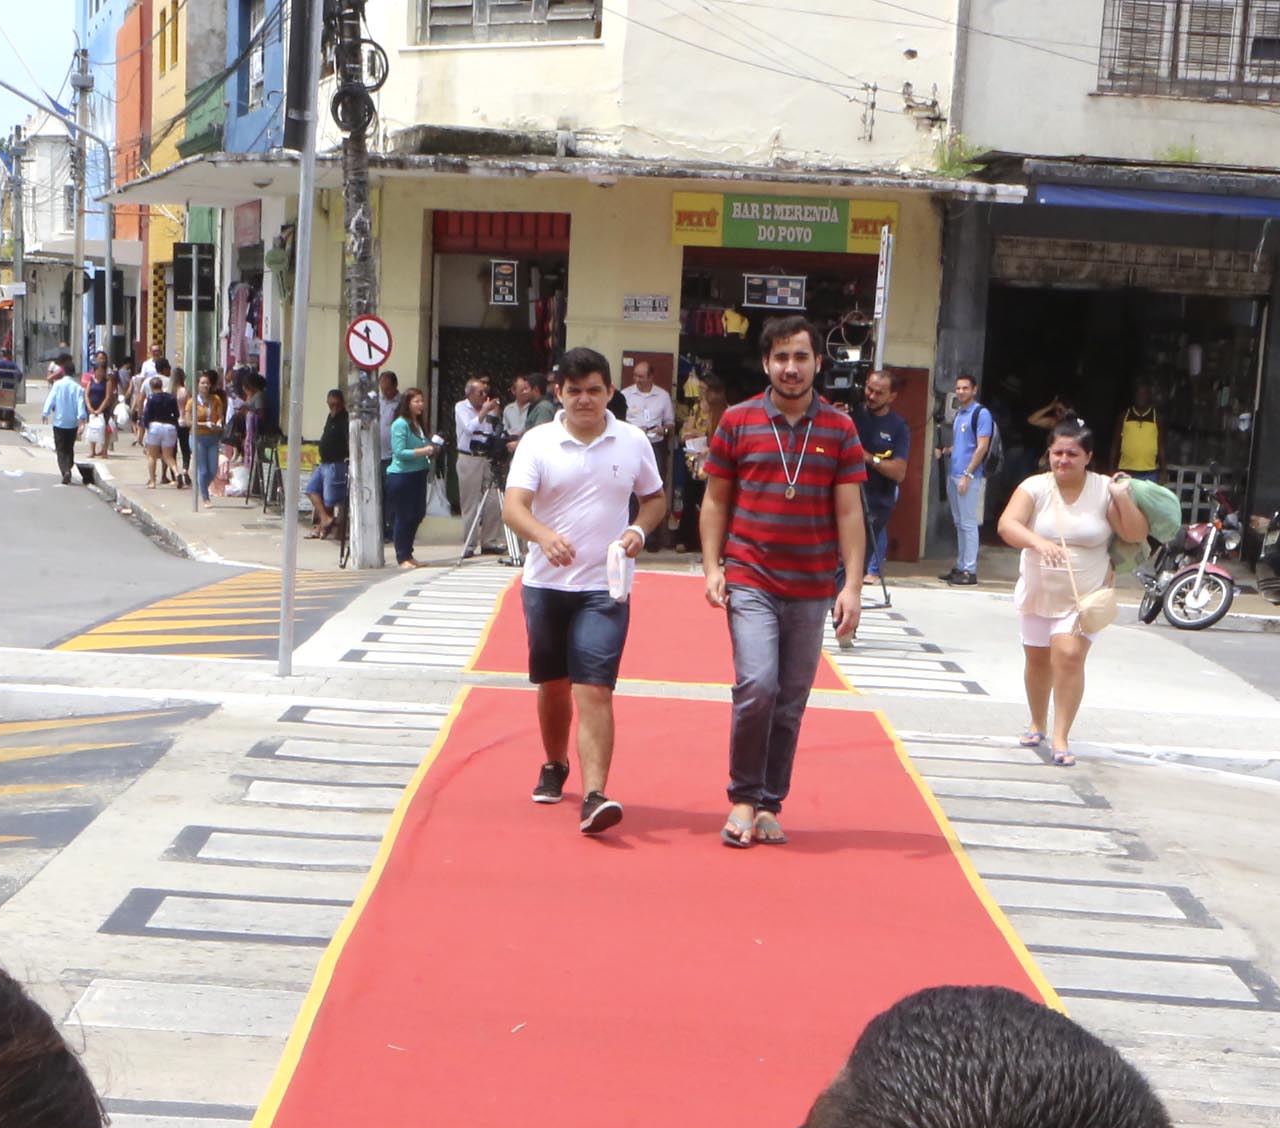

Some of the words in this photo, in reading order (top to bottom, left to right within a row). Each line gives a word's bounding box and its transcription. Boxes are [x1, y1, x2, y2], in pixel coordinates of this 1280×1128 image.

[732, 202, 761, 220] BAR
[763, 203, 773, 220] E
[774, 205, 840, 223] MERENDA
[757, 225, 776, 241] DO
[777, 226, 813, 243] POVO
